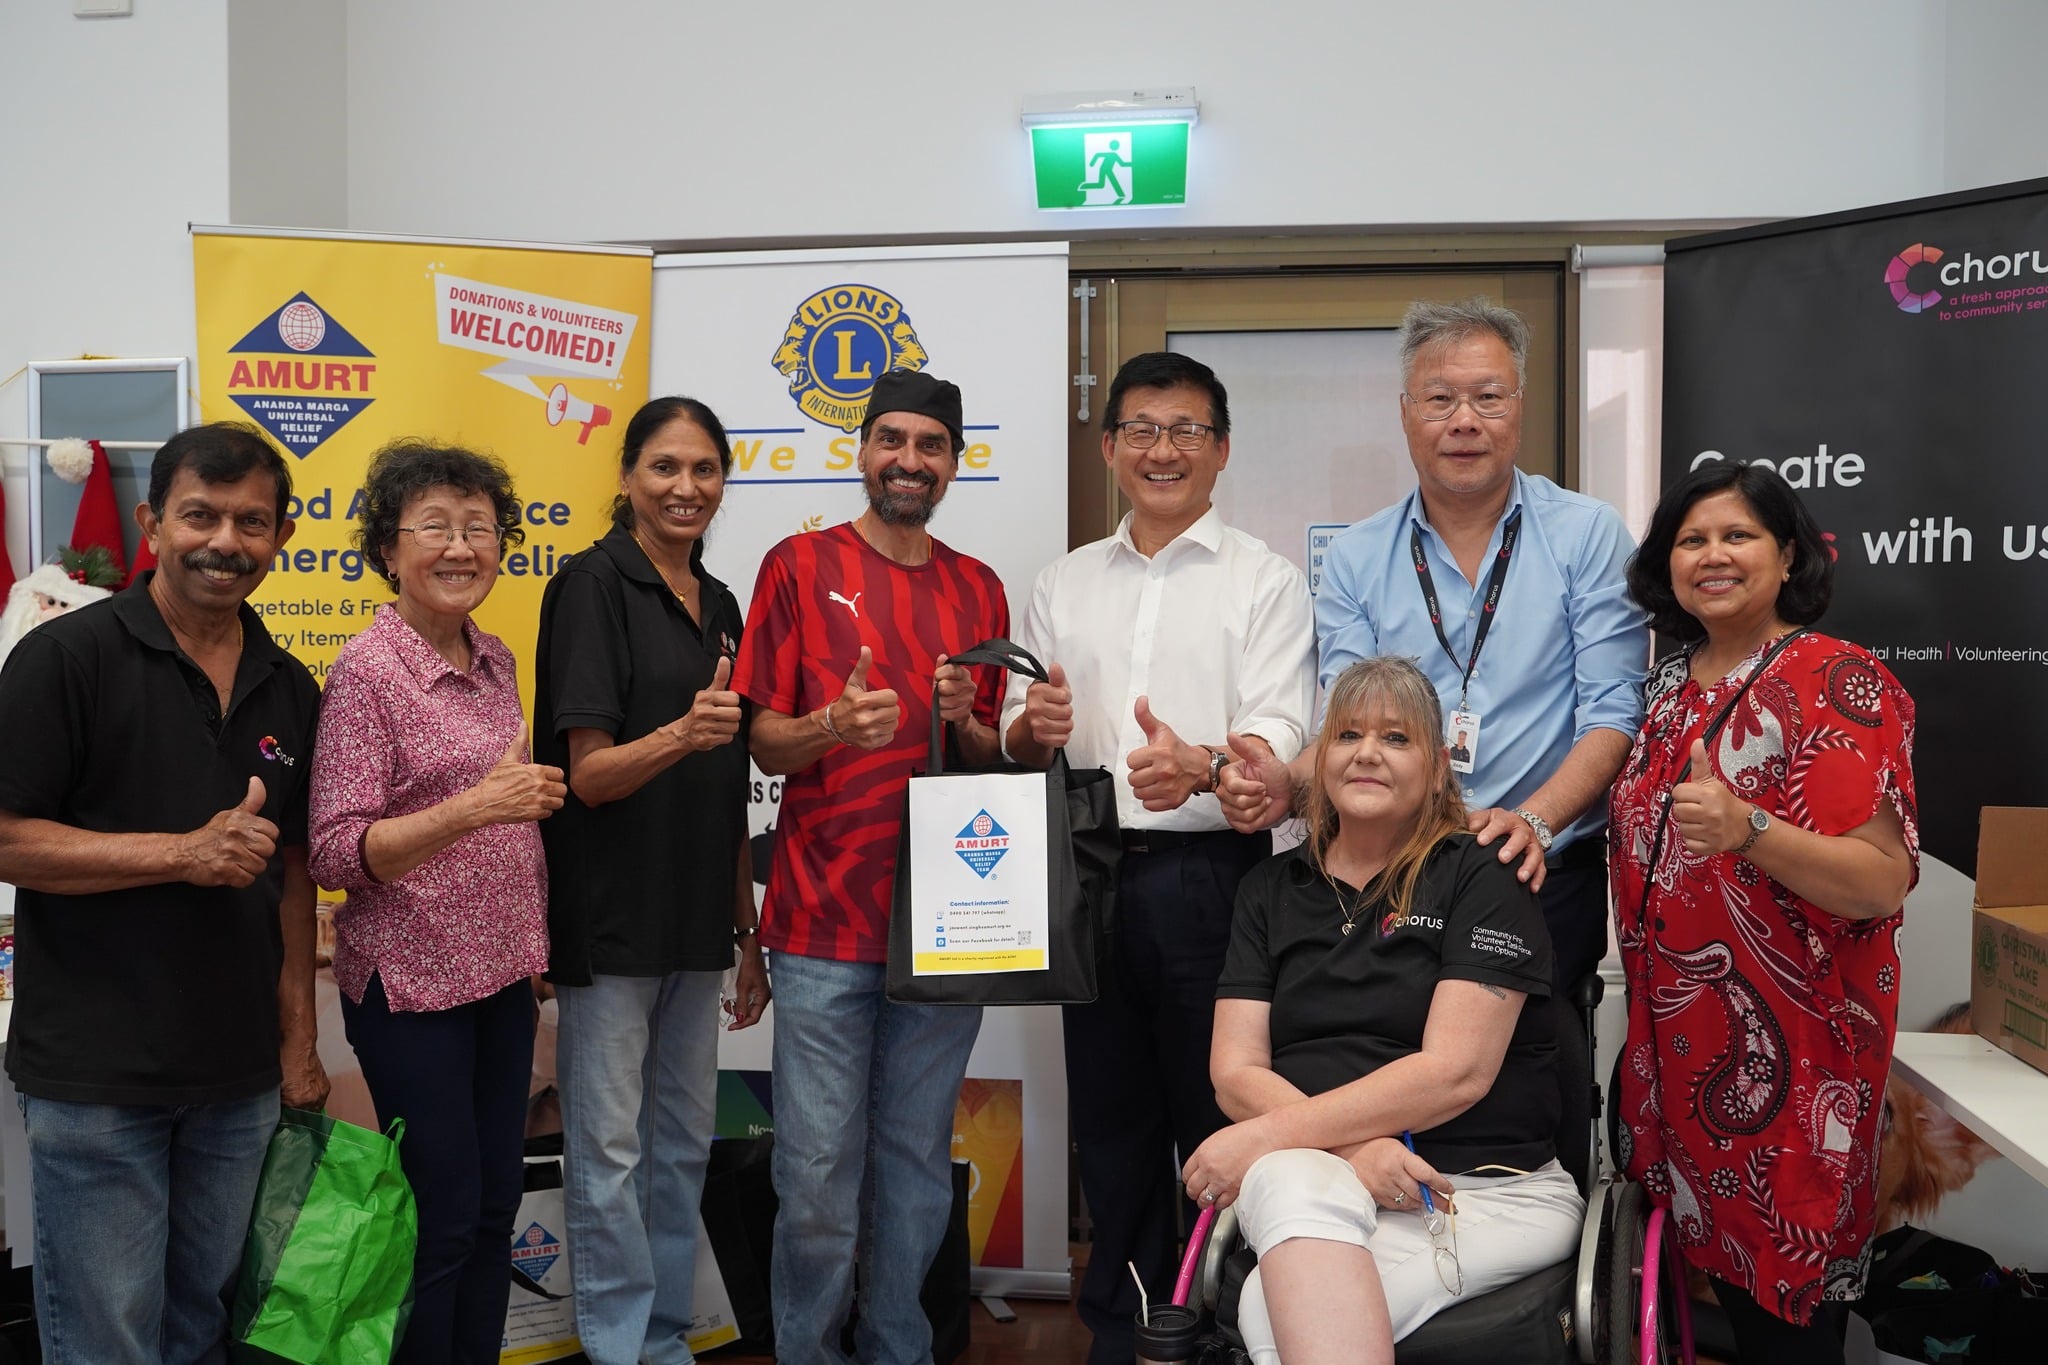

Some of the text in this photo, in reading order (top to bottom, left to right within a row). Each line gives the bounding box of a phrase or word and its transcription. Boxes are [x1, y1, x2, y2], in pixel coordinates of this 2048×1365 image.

[1940, 250, 2048, 287] choru
[806, 290, 894, 322] LIONS
[1949, 297, 1958, 306] a
[1961, 290, 1992, 304] fresh
[450, 287, 624, 335] DONATIONS & VOLUNTEERS
[1939, 311, 1952, 320] to
[1955, 301, 2023, 319] community
[450, 308, 616, 367] WELCOMED!
[833, 330, 873, 380] L
[228, 360, 377, 392] AMURT
[253, 400, 350, 412] ANANDA MARGA
[806, 394, 868, 421] INTERNATI
[268, 412, 335, 422] UNIVERSAL
[280, 423, 323, 433] RELIEF
[285, 434, 318, 443] TEAM
[287, 488, 332, 520] od
[1861, 516, 1973, 565] with
[1489, 584, 1499, 605] chorus
[252, 599, 333, 619] getable
[340, 599, 355, 616] &
[1896, 646, 1942, 660] Health
[954, 837, 1010, 849] AMURT
[1471, 933, 1506, 947] Volunteer
[1472, 926, 1513, 941] Community
[1470, 941, 1477, 949] &
[1477, 942, 1494, 952] Care
[2000, 933, 2048, 968] CHRISTMA
[2012, 960, 2039, 987] CAKE
[511, 1244, 561, 1259] AMURT
